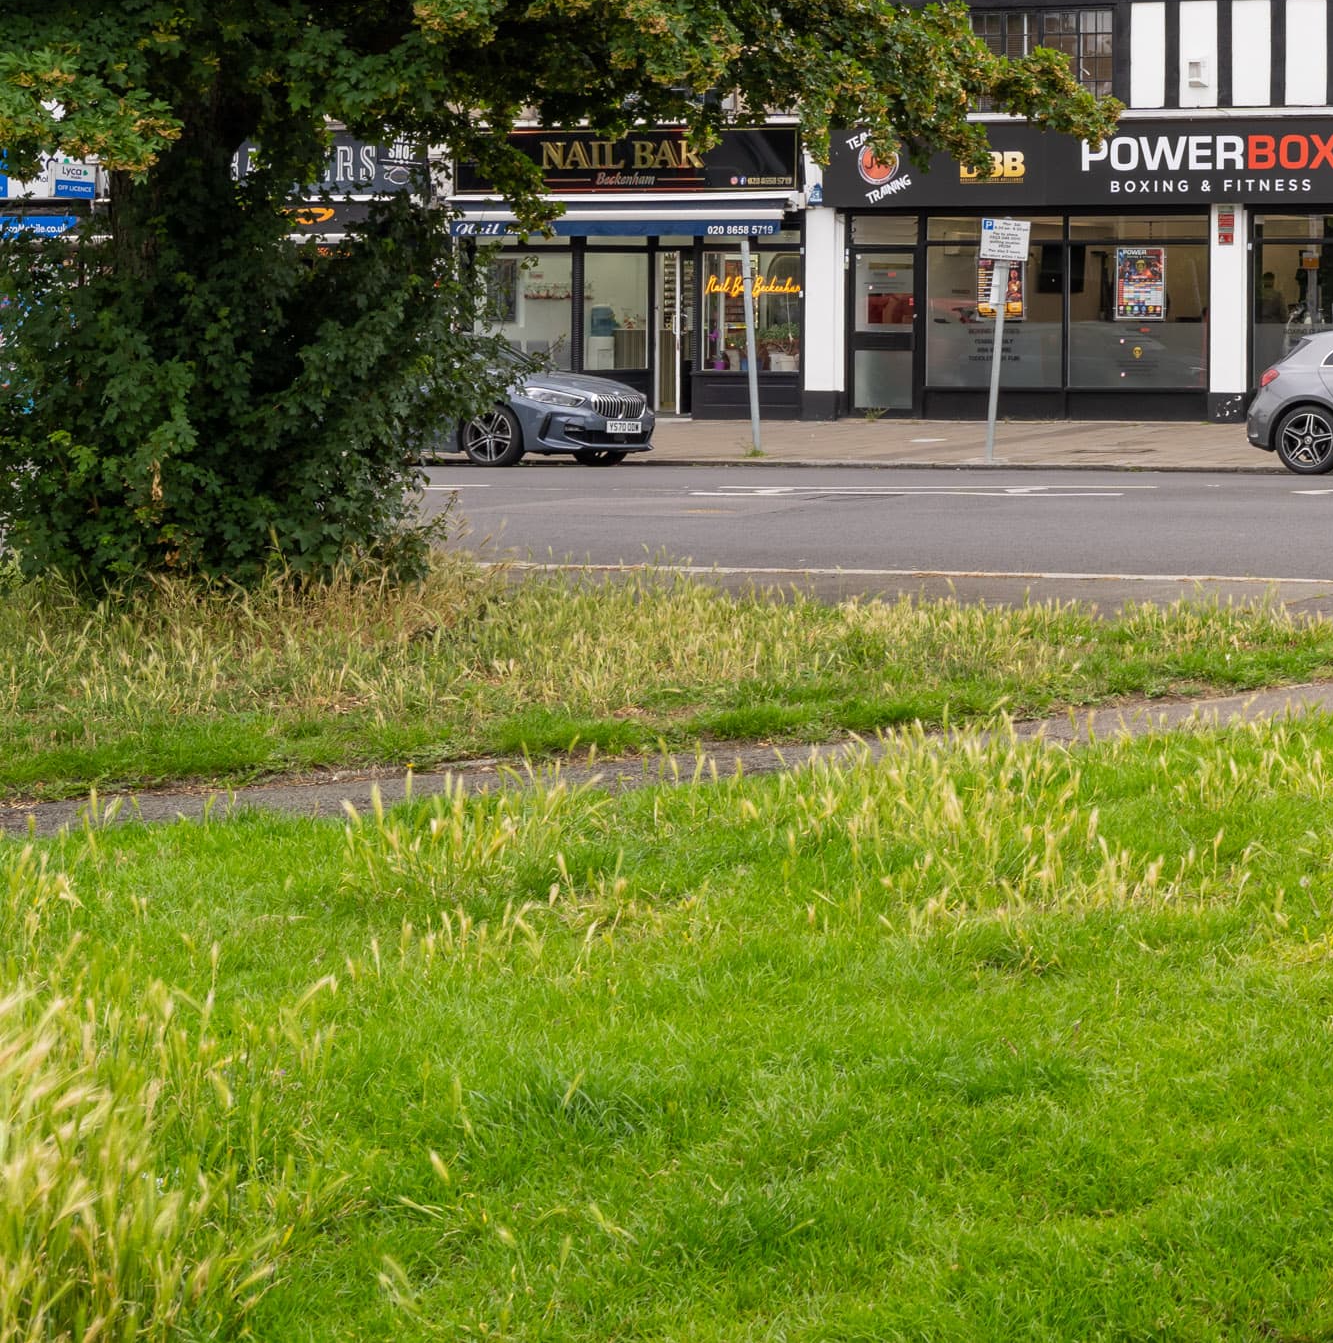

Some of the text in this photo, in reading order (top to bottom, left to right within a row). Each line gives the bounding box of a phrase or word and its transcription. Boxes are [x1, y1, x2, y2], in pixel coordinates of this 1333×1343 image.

[540, 140, 705, 169] NAIL BAR
[62, 166, 82, 176] Lyca
[596, 171, 656, 186] Beckenham
[58, 184, 92, 193] OFF LICENCE
[865, 174, 912, 204] TRAINING
[1110, 178, 1312, 193] BOXING & FITNESS
[707, 225, 774, 235] 020 8658 5719
[985, 221, 993, 230] P
[730, 275, 745, 297] Ba
